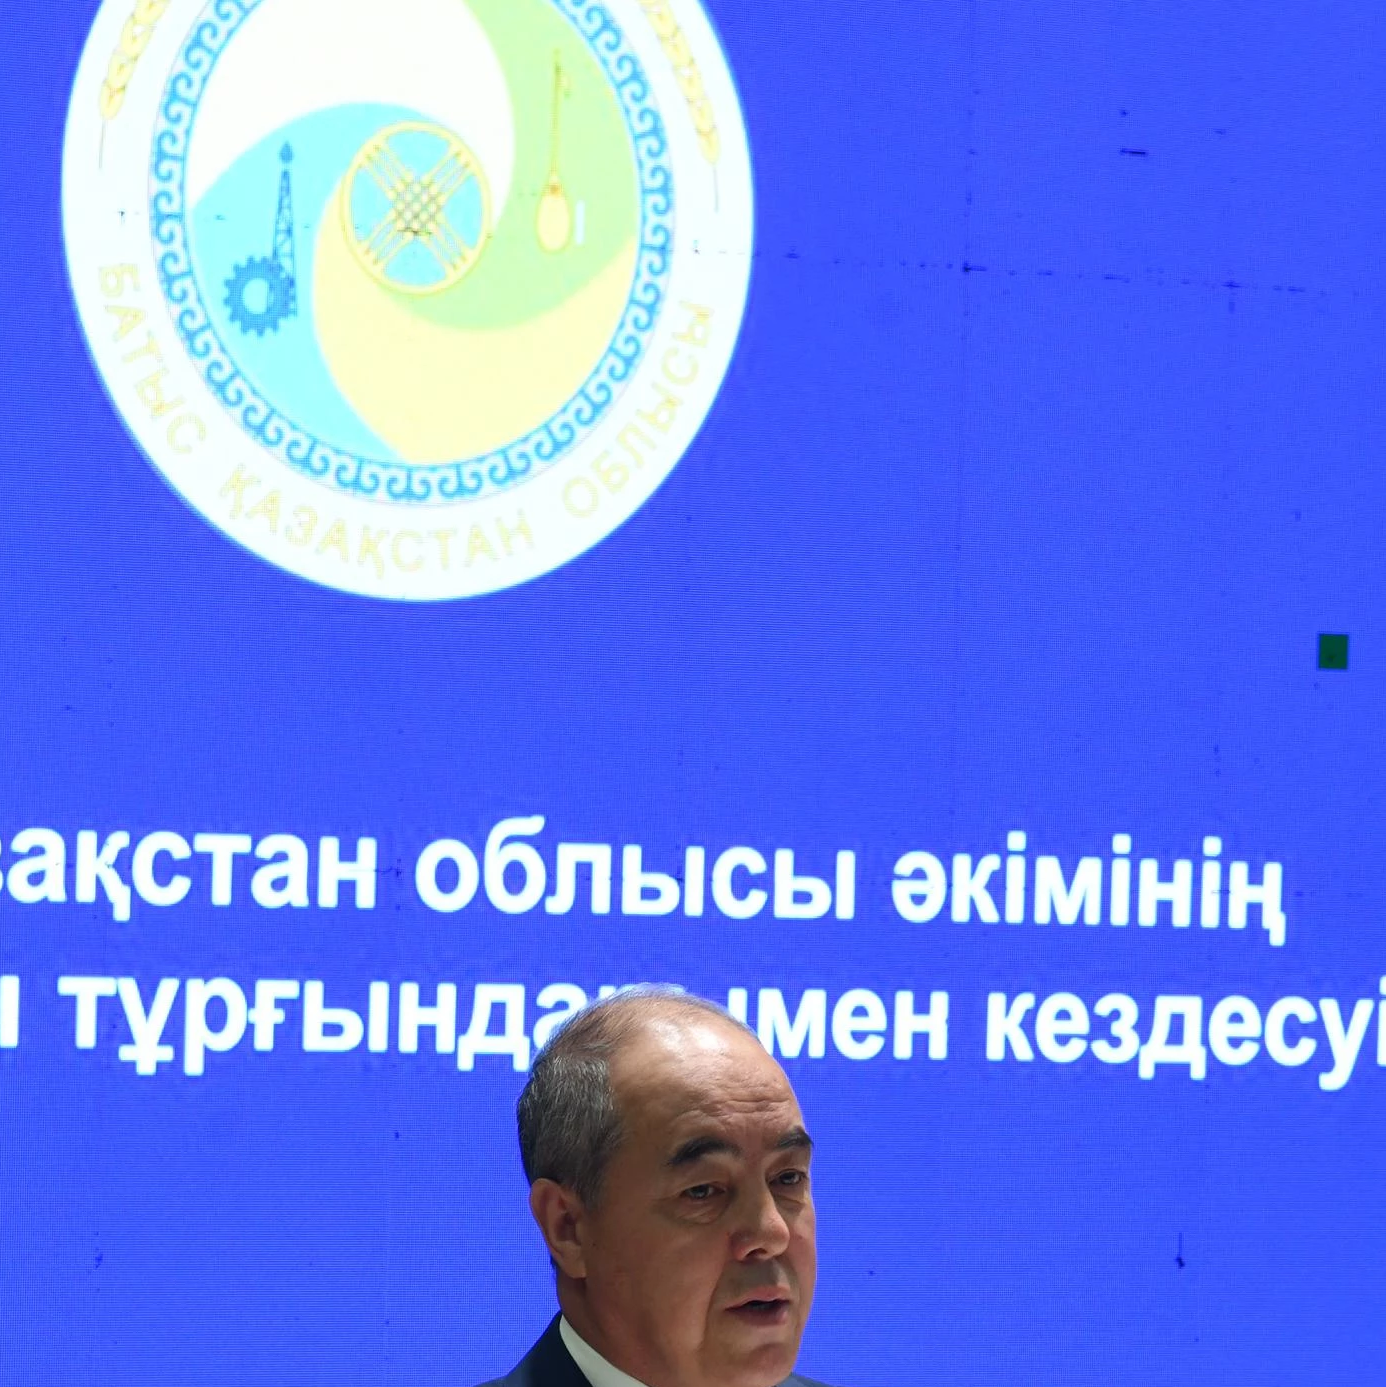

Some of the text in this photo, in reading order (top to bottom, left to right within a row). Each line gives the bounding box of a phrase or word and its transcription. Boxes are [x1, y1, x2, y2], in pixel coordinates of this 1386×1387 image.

[98, 262, 208, 453] БАТЫС
[559, 299, 714, 518] ОБЛЫСЫ
[414, 814, 857, 921] облысы
[890, 829, 1287, 947] әкімінің
[56, 975, 950, 1077] тұрғындамен
